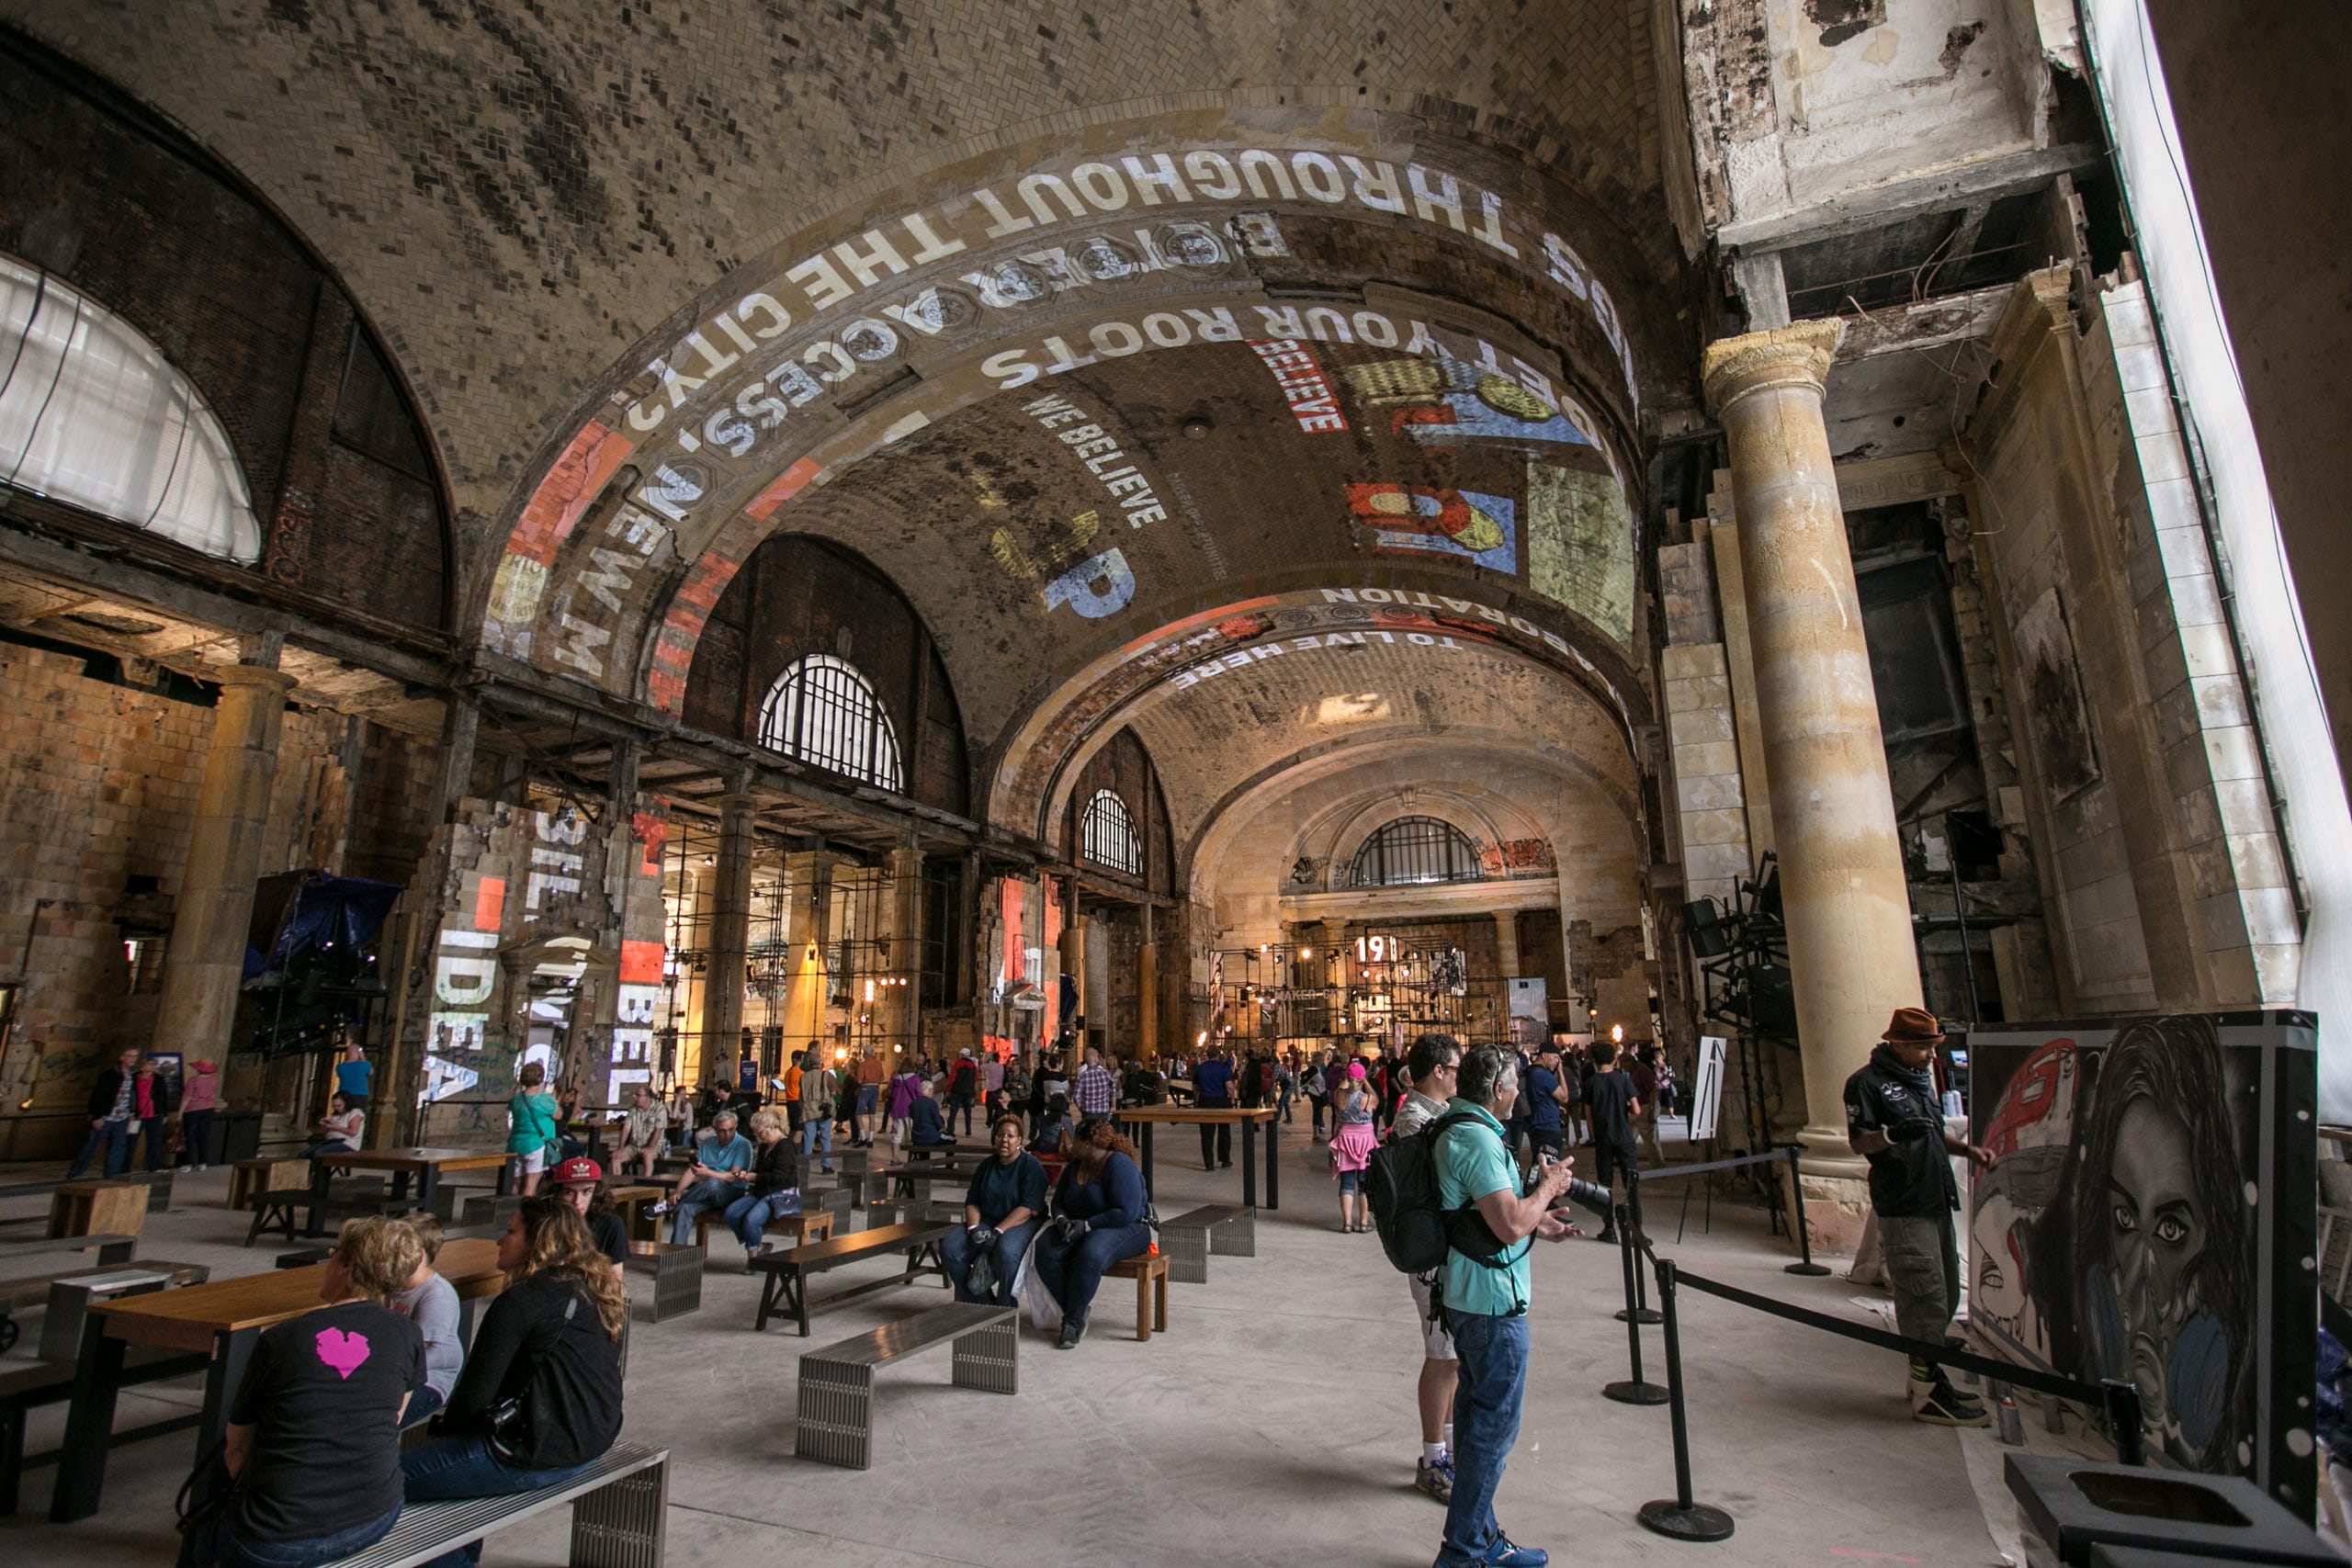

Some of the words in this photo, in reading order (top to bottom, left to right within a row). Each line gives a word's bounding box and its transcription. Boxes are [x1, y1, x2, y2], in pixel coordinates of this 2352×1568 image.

[973, 149, 1520, 258] THROUGHOUT
[786, 212, 966, 310] THE
[610, 292, 791, 431] CITY?
[679, 288, 945, 449] ACCESS,
[980, 306, 1240, 389] ROOTS
[1250, 306, 1463, 359] YOUR
[1253, 339, 1342, 433] BELIEVE
[1022, 392, 1072, 431] WE
[1057, 421, 1168, 530] BELIEVE
[577, 464, 704, 614] NEW
[1170, 643, 1283, 690] HERE
[1294, 631, 1394, 651] LIVE
[1400, 631, 1464, 651] TO
[417, 929, 500, 1108] IDEA
[1274, 988, 1317, 1001] MAKER
